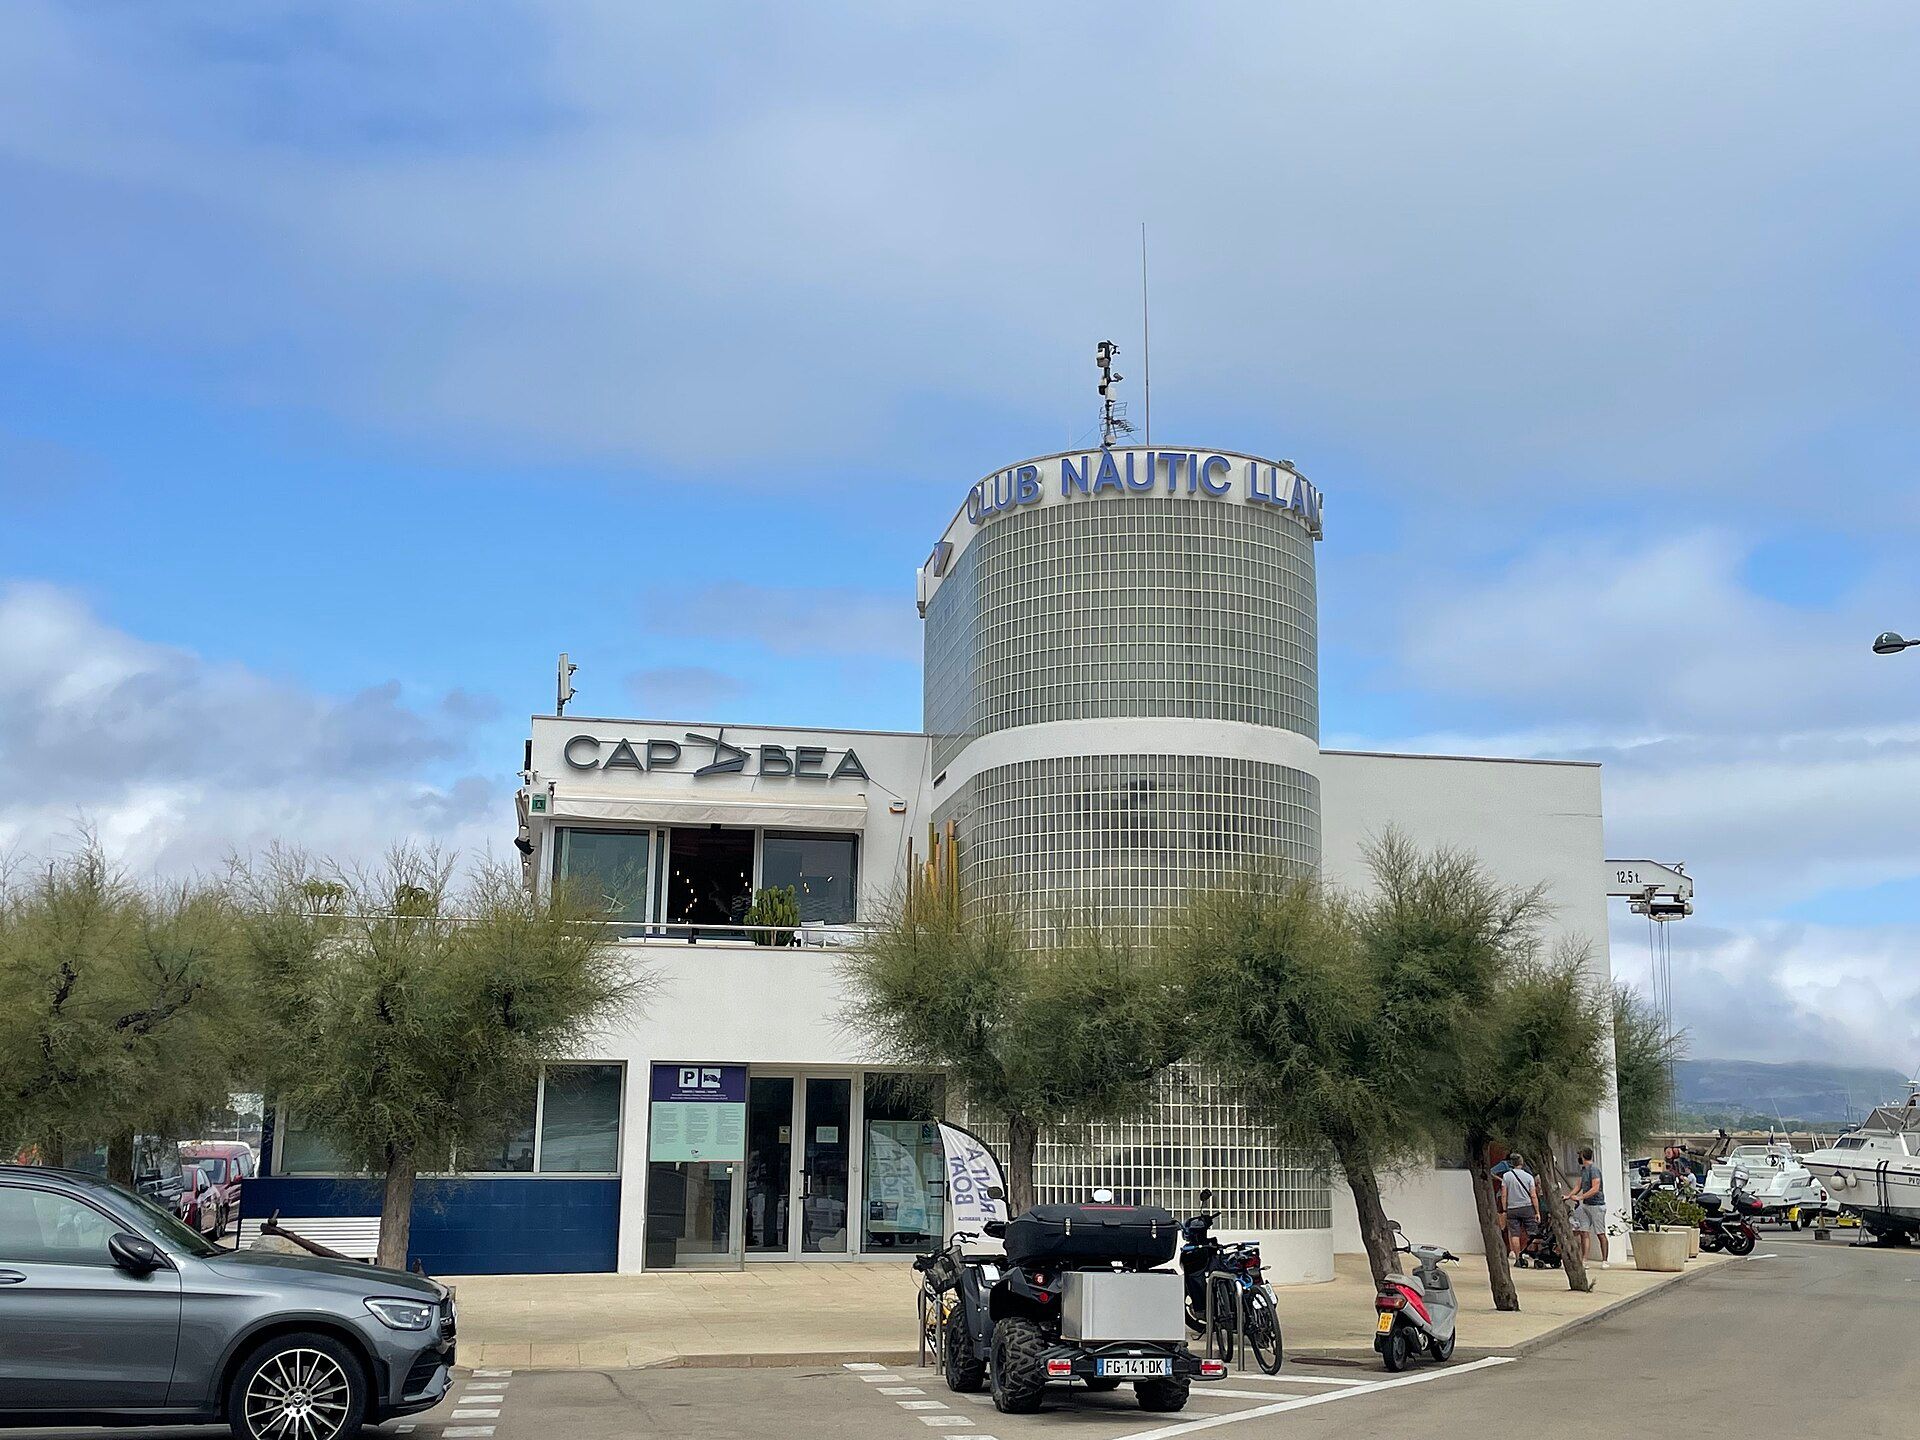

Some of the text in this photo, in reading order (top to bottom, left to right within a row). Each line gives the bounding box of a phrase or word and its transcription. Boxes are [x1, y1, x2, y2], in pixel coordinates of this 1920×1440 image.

[967, 464, 1043, 525] CLUB
[564, 734, 870, 780] CAP BEA
[1616, 870, 1633, 884] 12,5
[683, 1070, 695, 1085] P
